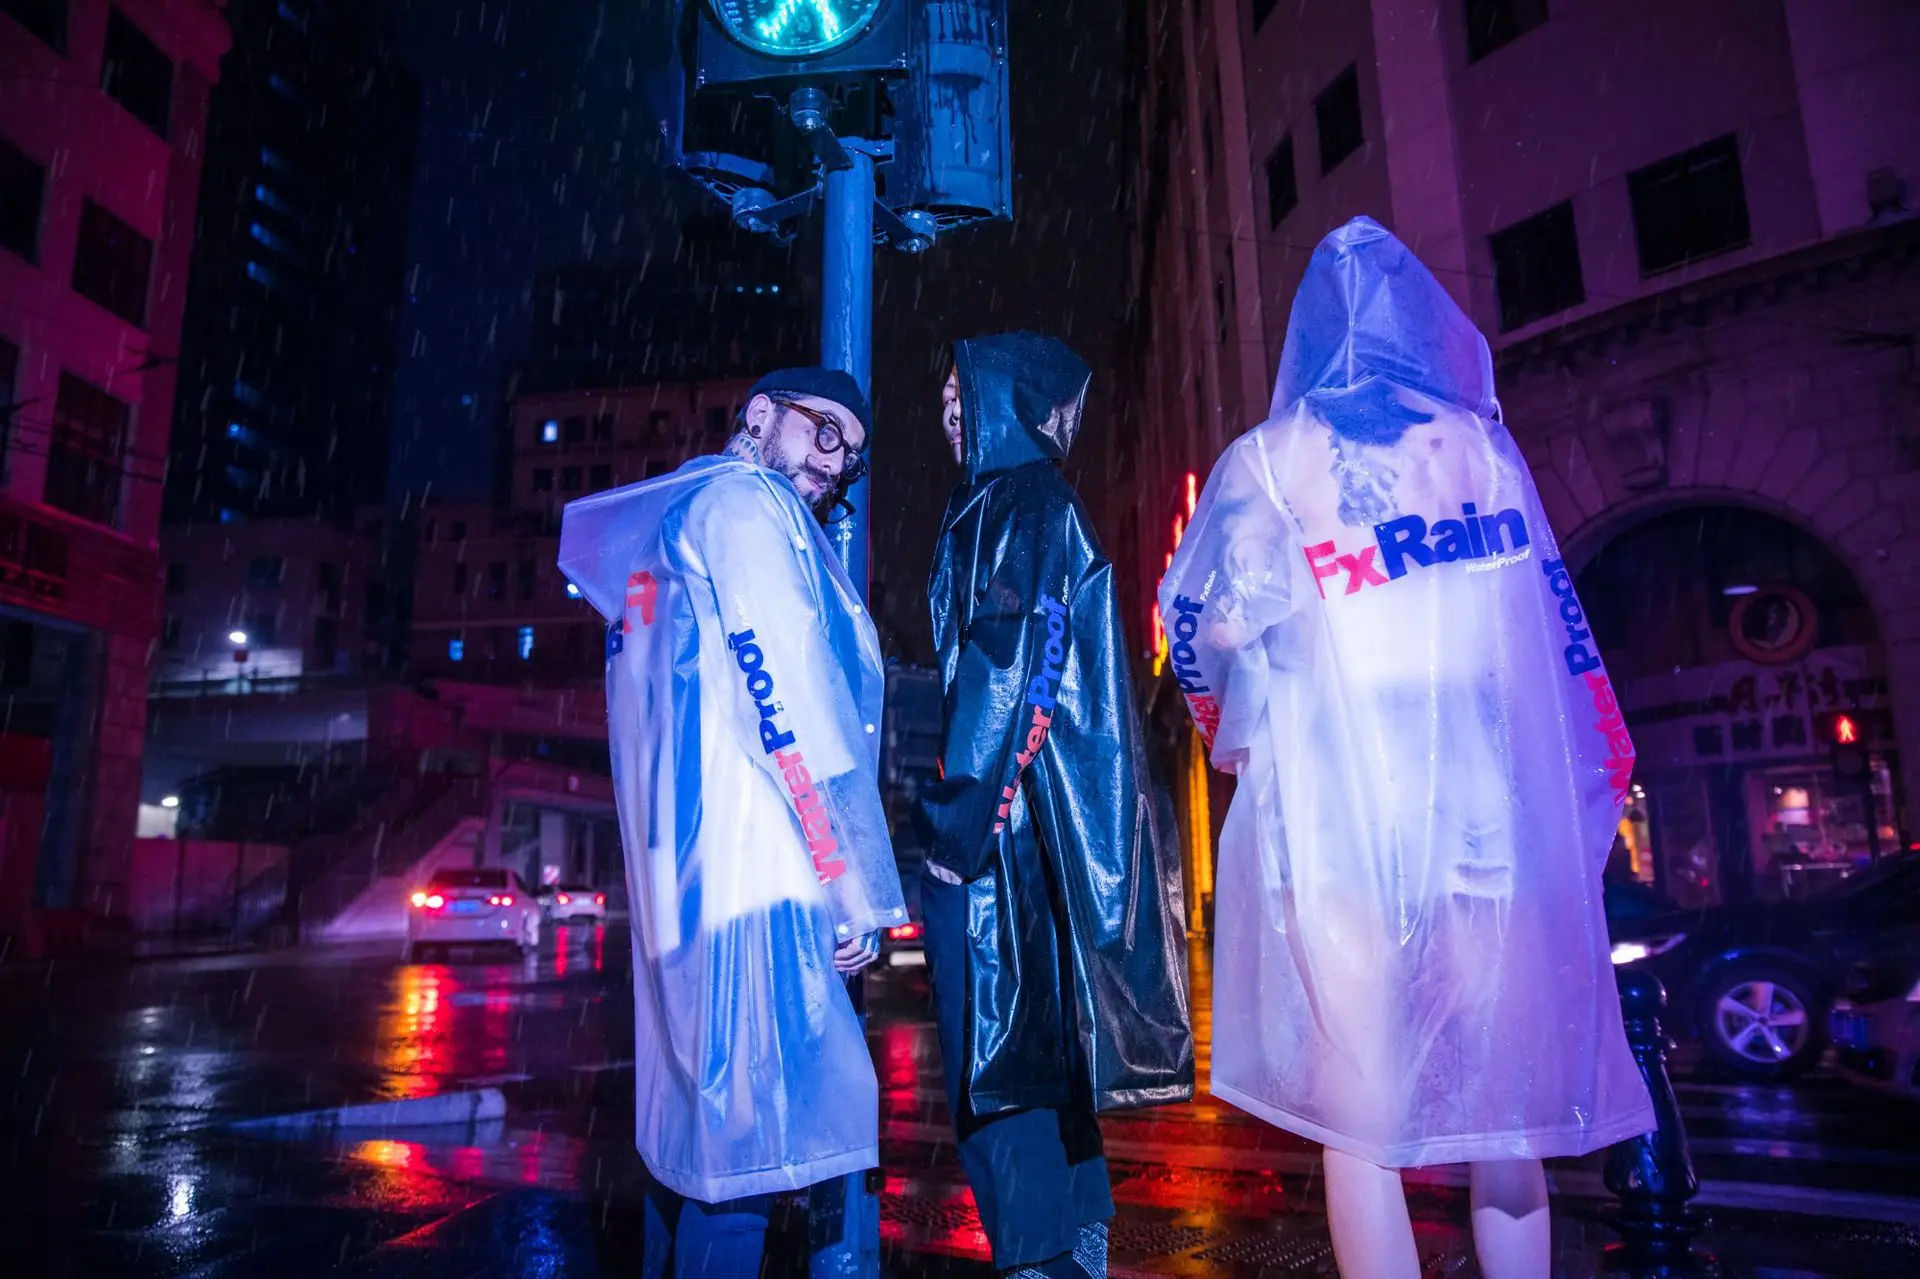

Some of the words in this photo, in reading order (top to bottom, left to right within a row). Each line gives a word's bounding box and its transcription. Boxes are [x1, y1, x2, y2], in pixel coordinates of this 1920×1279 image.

[1302, 502, 1530, 599] FxRain
[1464, 548, 1531, 573] WaterProof
[1200, 570, 1217, 602] FxRain
[728, 629, 846, 884] WaterProof
